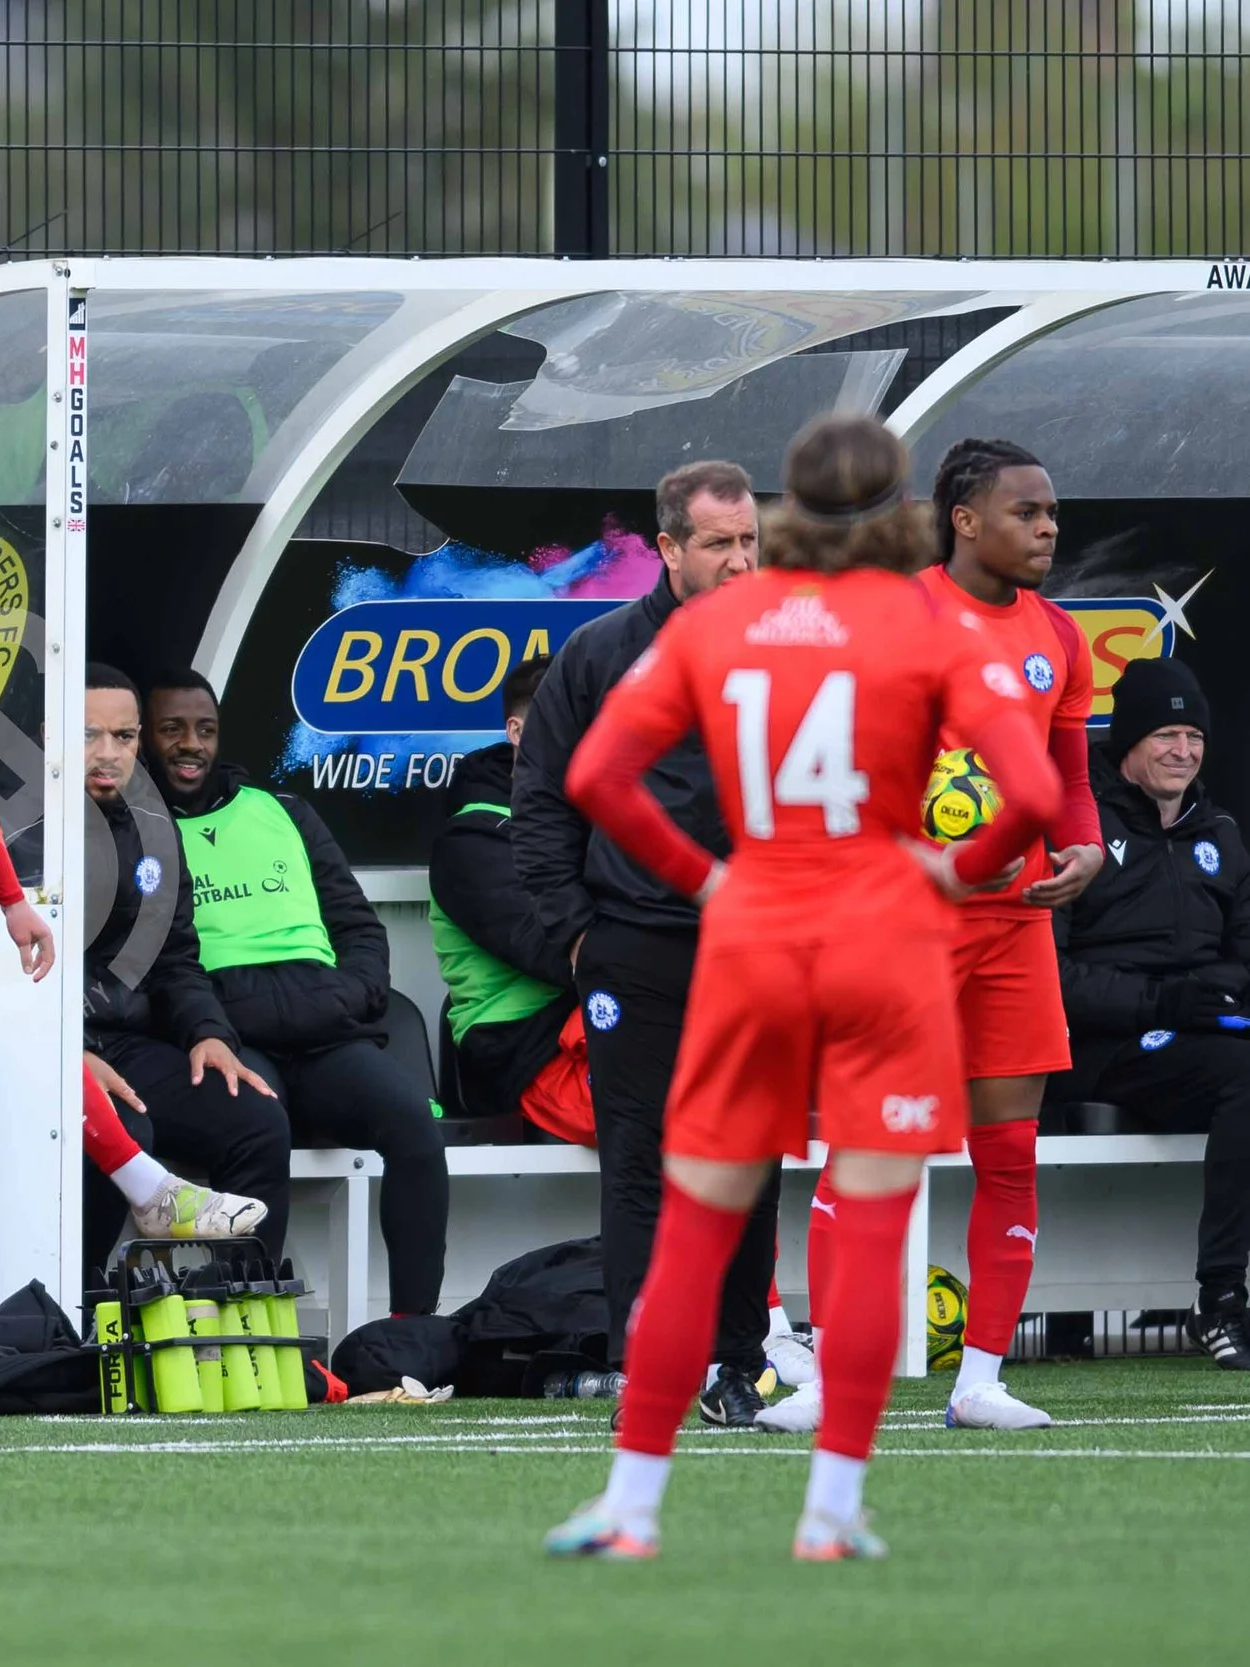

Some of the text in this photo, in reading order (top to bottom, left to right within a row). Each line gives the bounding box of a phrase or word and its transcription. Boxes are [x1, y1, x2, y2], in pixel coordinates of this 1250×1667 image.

[1206, 264, 1250, 289] AW
[312, 753, 396, 789] WIDE
[721, 668, 871, 841] 14
[105, 1319, 123, 1398] FORA
